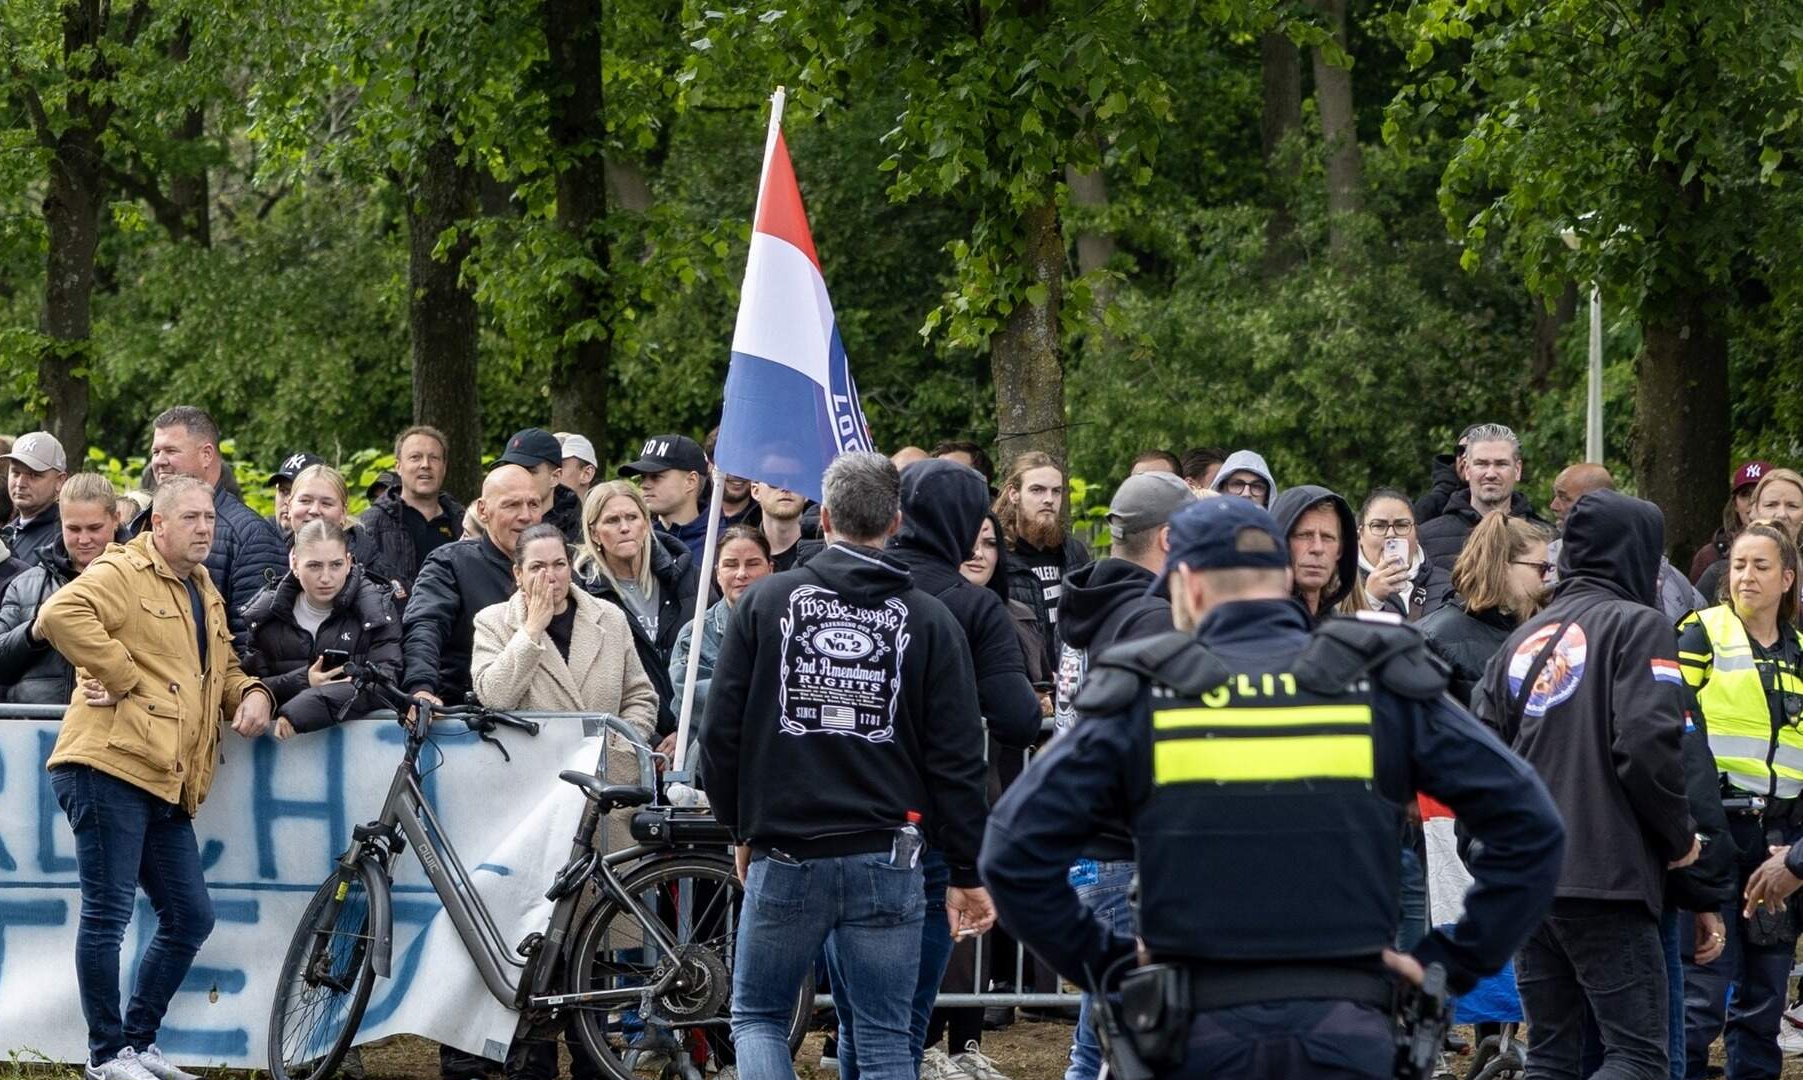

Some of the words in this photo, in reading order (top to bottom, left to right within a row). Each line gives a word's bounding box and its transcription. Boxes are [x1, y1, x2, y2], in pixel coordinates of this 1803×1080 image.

[795, 656, 816, 674] 2nd
[819, 657, 886, 682] Amendment
[798, 674, 881, 692] RIGHTS
[796, 707, 817, 719] SINCE
